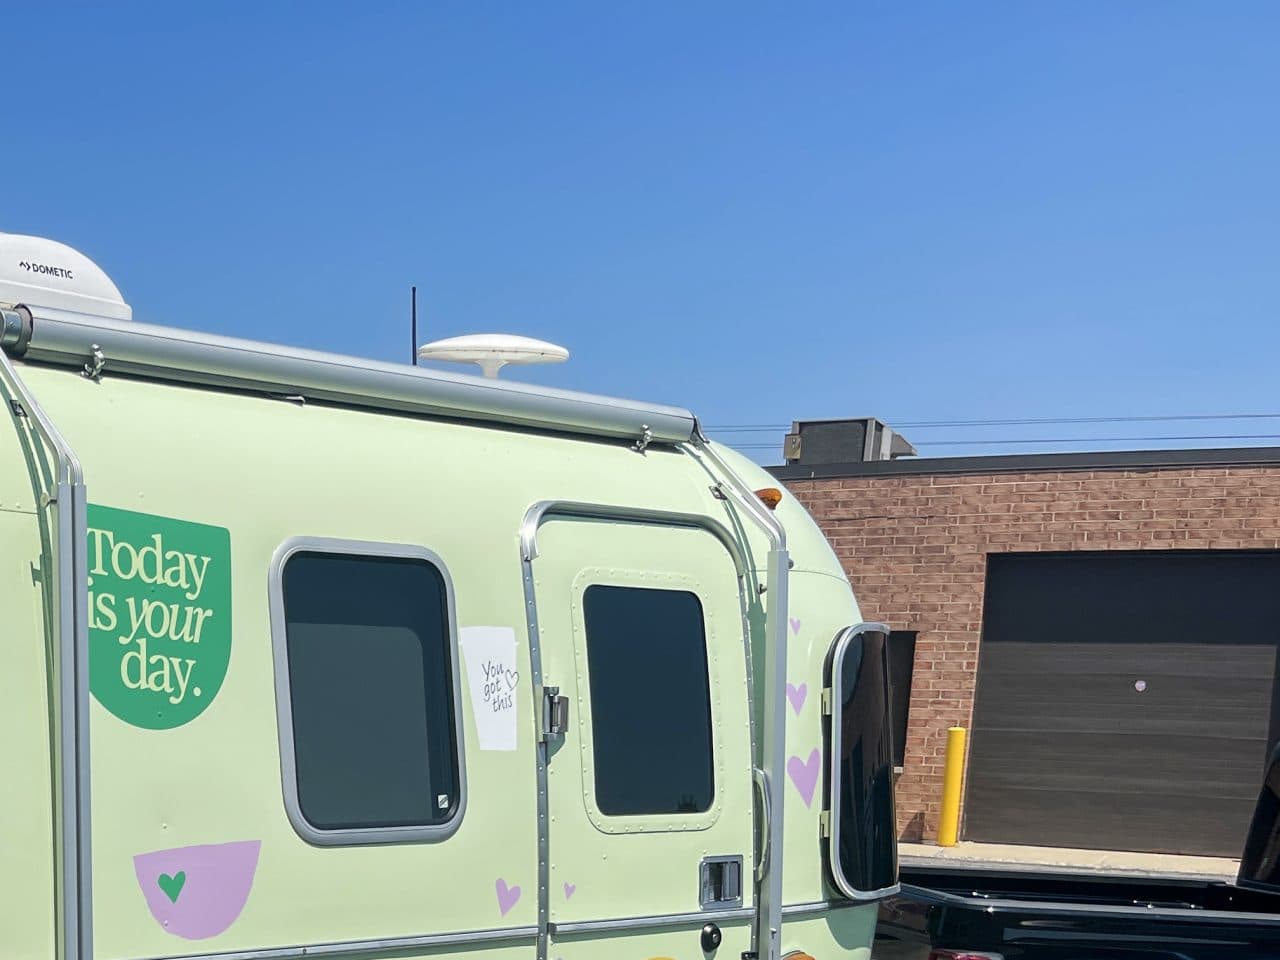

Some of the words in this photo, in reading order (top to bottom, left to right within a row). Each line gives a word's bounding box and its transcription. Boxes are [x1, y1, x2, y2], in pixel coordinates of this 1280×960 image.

[32, 263, 73, 279] DOMETIC
[87, 528, 211, 600] Today
[119, 597, 213, 645] your
[121, 638, 202, 704] day.
[481, 660, 504, 681] You
[483, 678, 502, 702] got
[492, 692, 513, 712] this
